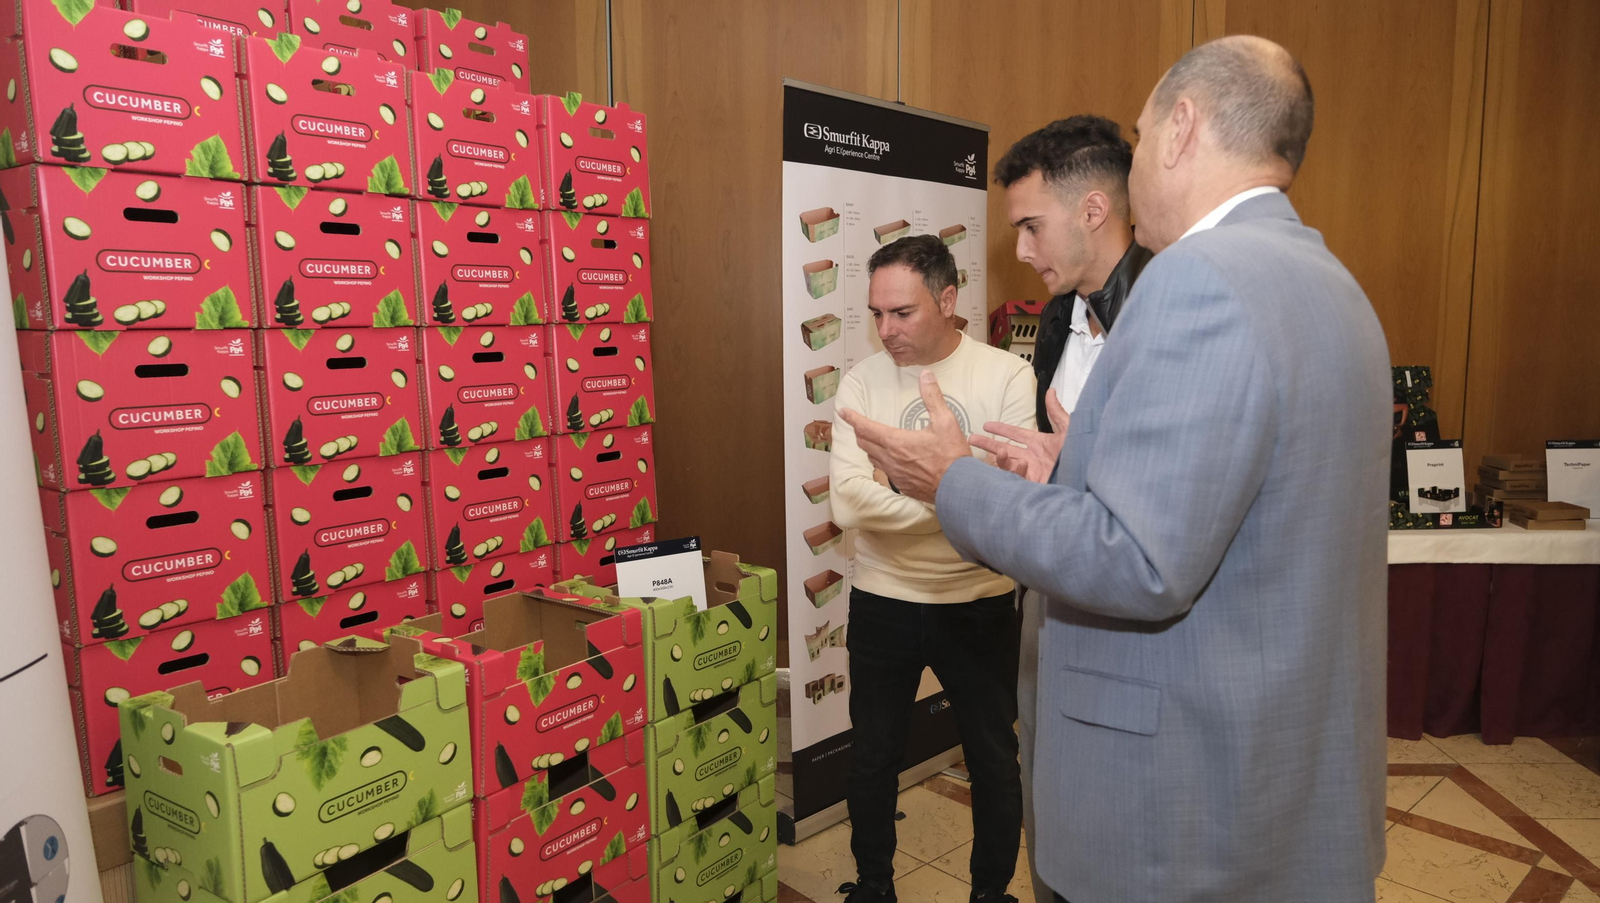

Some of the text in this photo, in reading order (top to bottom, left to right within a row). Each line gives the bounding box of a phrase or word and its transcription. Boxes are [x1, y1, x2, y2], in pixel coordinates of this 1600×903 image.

[94, 92, 181, 113] CUCUMBER
[299, 120, 365, 137] CUCUMBER
[823, 126, 890, 155] Smurfit Kappa
[453, 144, 505, 159] CUCUMBER
[824, 144, 836, 154] Agri
[864, 152, 880, 161] Centre
[580, 161, 621, 173] CUCUMBER
[107, 256, 191, 268] CUCUMBER
[307, 264, 370, 274] CUCUMBER
[457, 269, 508, 278] CUCUMBER
[582, 273, 623, 281] CUCUMBER
[586, 379, 626, 388] CUCUMBER
[463, 388, 513, 399] CUCUMBER
[314, 398, 377, 410] CUCUMBER
[119, 409, 202, 424] CUCUMBER
[589, 482, 629, 496] CUCUMBER
[469, 501, 518, 516] CUCUMBER
[321, 524, 384, 542] CUCUMBER
[132, 554, 213, 575] CUCUMBER
[166, 574, 196, 582] WORKSHOP
[652, 578, 672, 586] P848A
[698, 646, 737, 666] CUCUMBER
[542, 700, 593, 727] CUCUMBER
[699, 752, 738, 776] CUCUMBER
[327, 778, 398, 816] CUCUMBER
[148, 798, 194, 827] CUCUMBER
[546, 823, 597, 855] CUCUMBER
[700, 854, 738, 881] CUCUMBER
